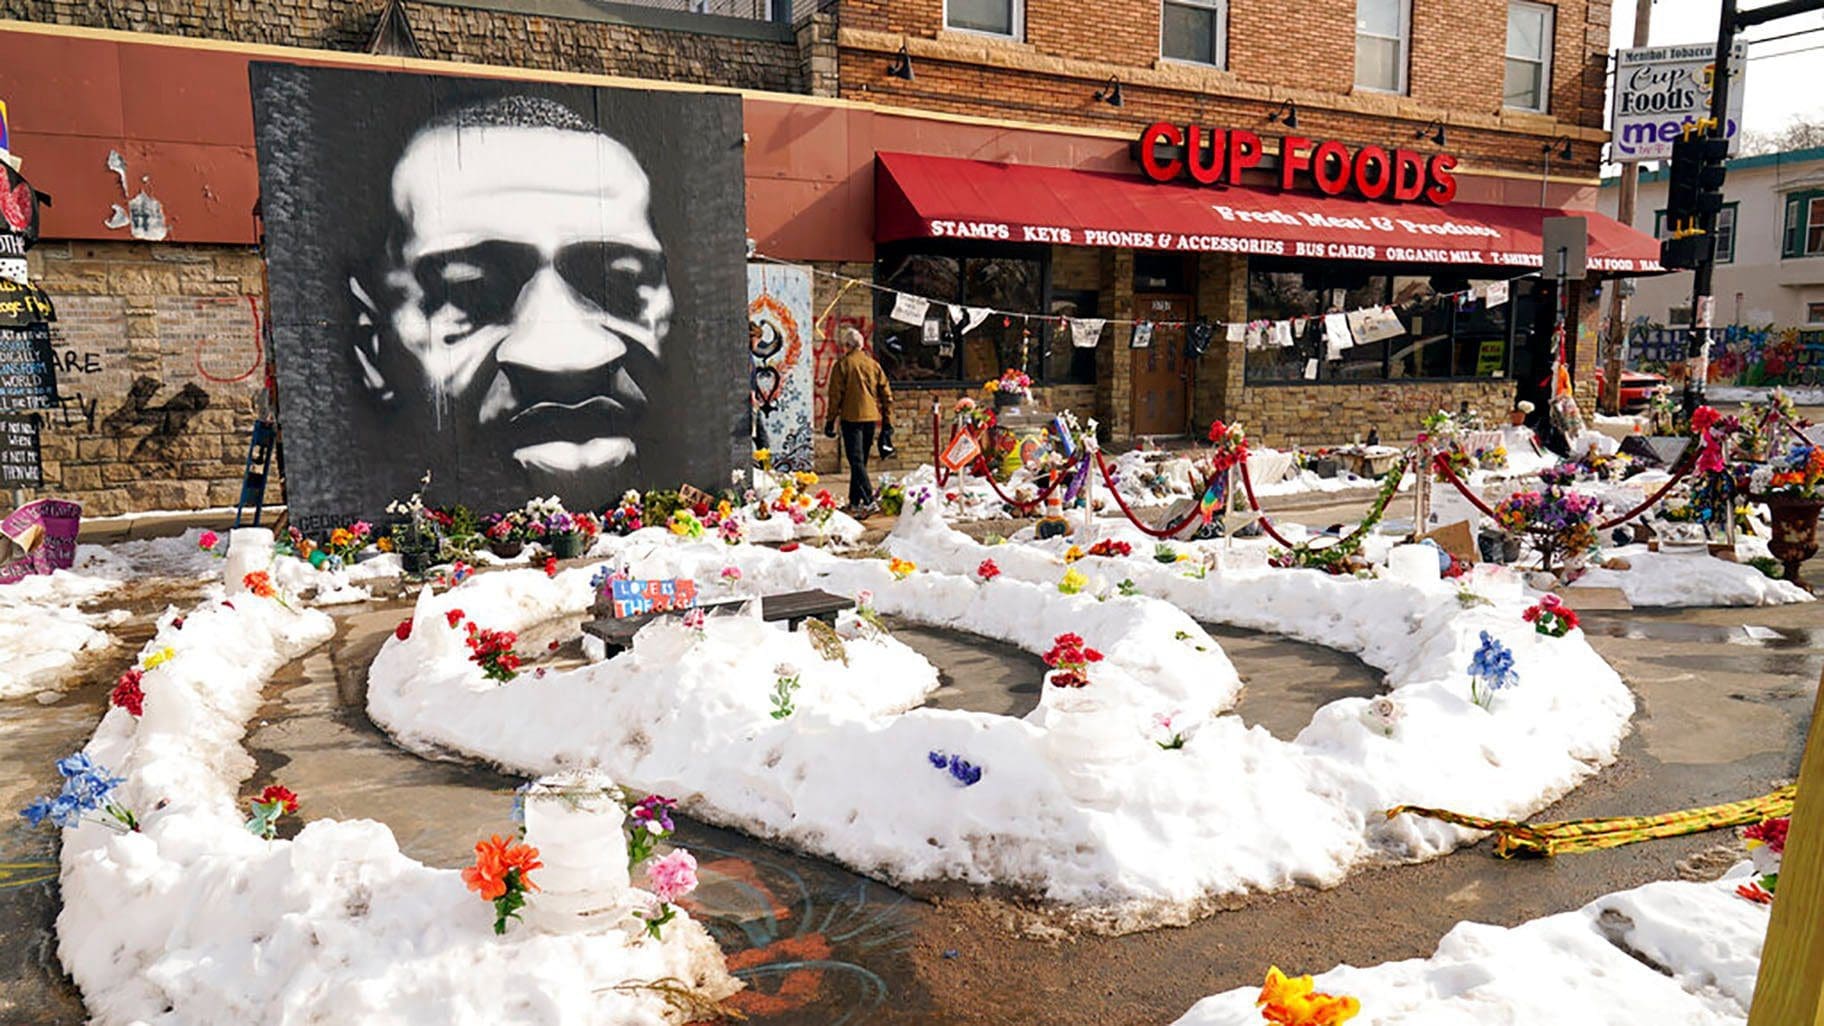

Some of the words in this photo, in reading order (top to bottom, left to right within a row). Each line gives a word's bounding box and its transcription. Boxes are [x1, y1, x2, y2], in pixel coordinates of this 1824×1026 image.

[1625, 49, 1667, 62] Menthol
[1669, 46, 1713, 58] Tobacco
[1629, 65, 1685, 92] Cup
[1140, 122, 1263, 186] CUP
[1281, 135, 1459, 206] FOODS
[1211, 205, 1302, 225] Fresh
[1297, 212, 1371, 230] Meat
[1369, 217, 1394, 231] &
[1395, 218, 1501, 238] Produce
[930, 220, 1010, 239] STAMPS
[1022, 226, 1072, 242] KEYS
[1084, 229, 1154, 247] PHONES
[1158, 234, 1173, 248] &
[1176, 235, 1285, 255] ACCESSORIES
[1295, 242, 1325, 256] BUS
[1327, 243, 1376, 259] CARDS
[1385, 247, 1448, 262] ORGANIC
[1449, 250, 1484, 263] MILK
[1586, 257, 1603, 270] AN
[1604, 259, 1634, 271] FOOD
[52, 350, 103, 374] ARE
[1, 374, 43, 388] WORLD
